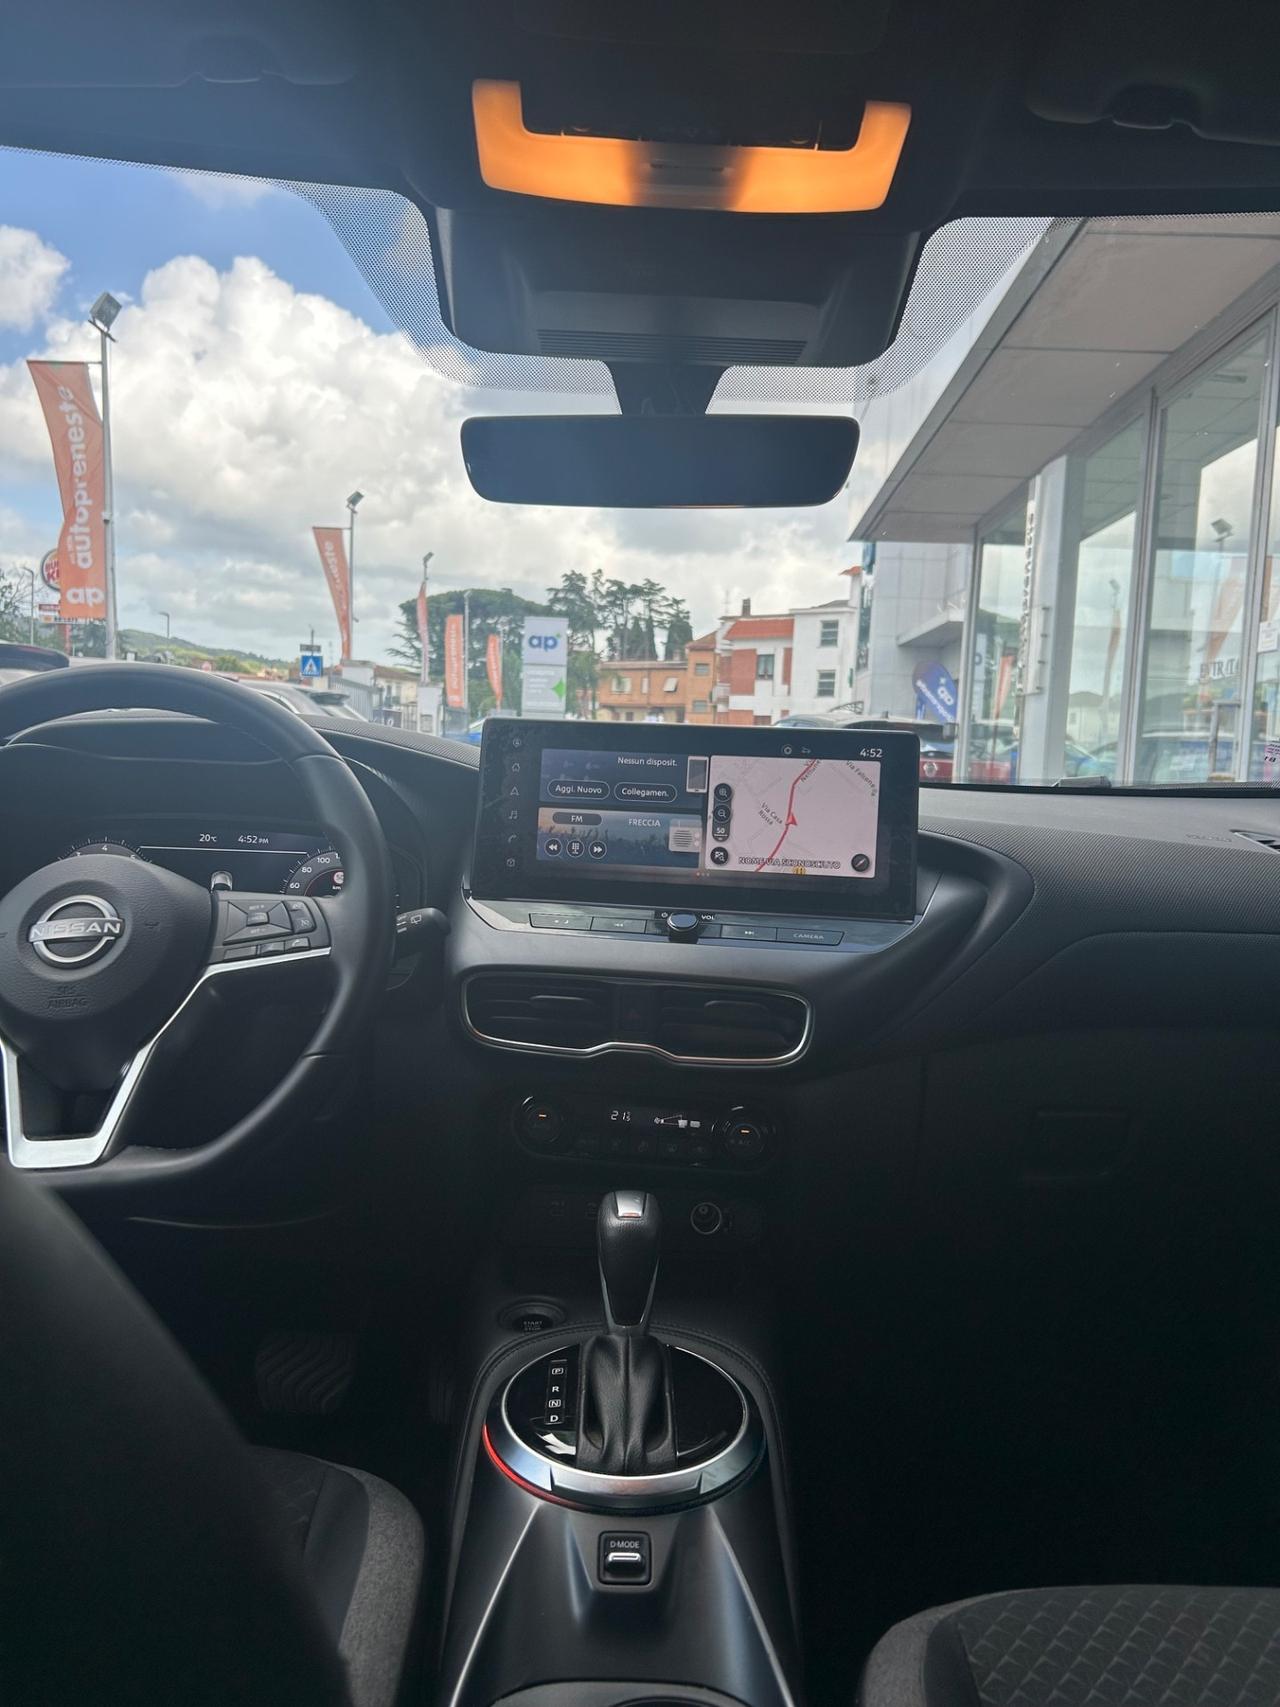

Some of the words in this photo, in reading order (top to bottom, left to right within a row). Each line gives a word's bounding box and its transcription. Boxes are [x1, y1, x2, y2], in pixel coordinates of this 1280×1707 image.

[58, 385, 92, 569] autopreneste
[528, 635, 558, 652] ap
[860, 748, 883, 758] 4:52
[617, 756, 645, 765] Nessun
[646, 758, 678, 768] disposit.
[577, 785, 602, 794] Nuovo
[621, 787, 670, 798] Collegamen.
[571, 815, 583, 823] FM
[628, 818, 661, 828] FRECCIA
[237, 834, 258, 844] 4:52
[102, 844, 108, 852] 4
[301, 866, 312, 874] 80
[701, 913, 716, 921] VOL
[31, 922, 121, 939] NISSAN
[551, 1385, 560, 1393] R
[550, 1414, 559, 1423] D
